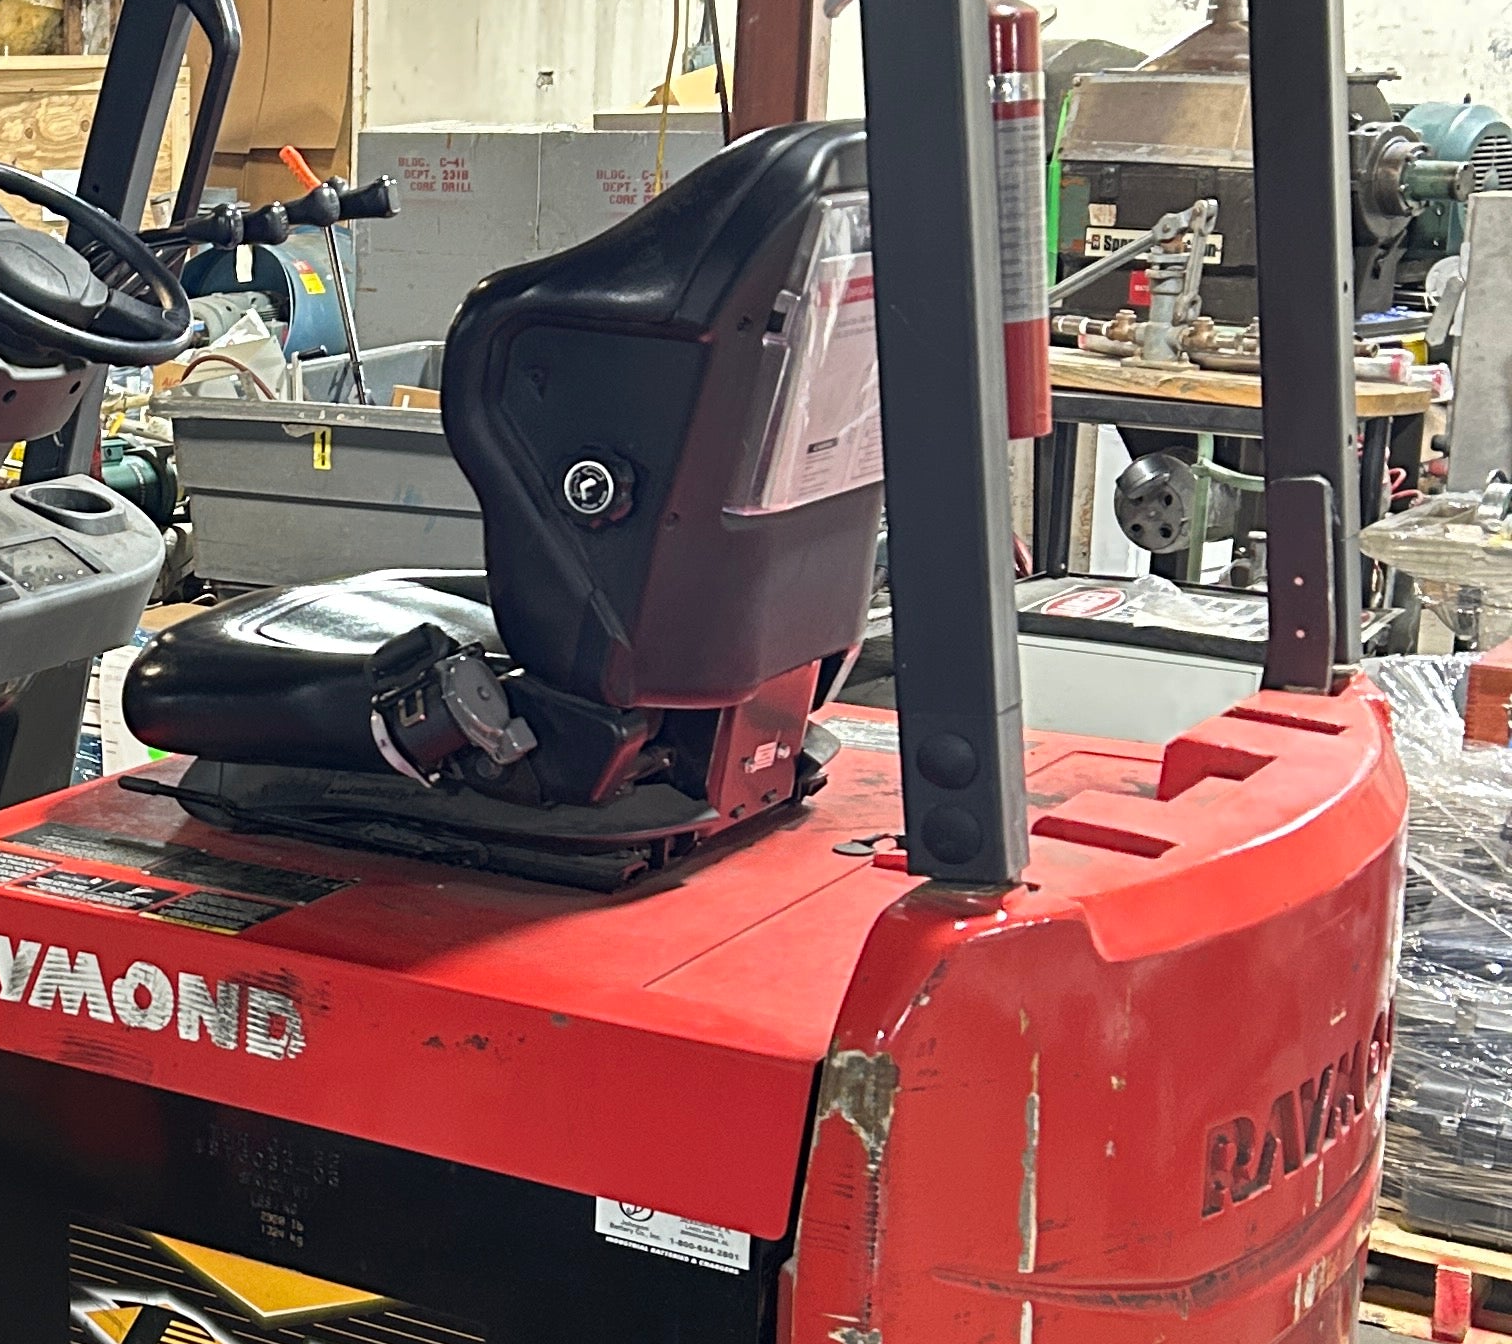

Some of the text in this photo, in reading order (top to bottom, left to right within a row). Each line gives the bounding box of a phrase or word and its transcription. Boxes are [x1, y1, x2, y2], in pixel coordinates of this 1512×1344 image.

[398, 157, 430, 167] BLDG.
[404, 169, 436, 179] DEPT.
[596, 169, 669, 180] BLDG. C-1
[410, 181, 474, 192] CORE DRILL
[602, 182, 637, 192] DEPT.
[609, 194, 637, 205] CORE
[1201, 1000, 1395, 1218] RAYMO
